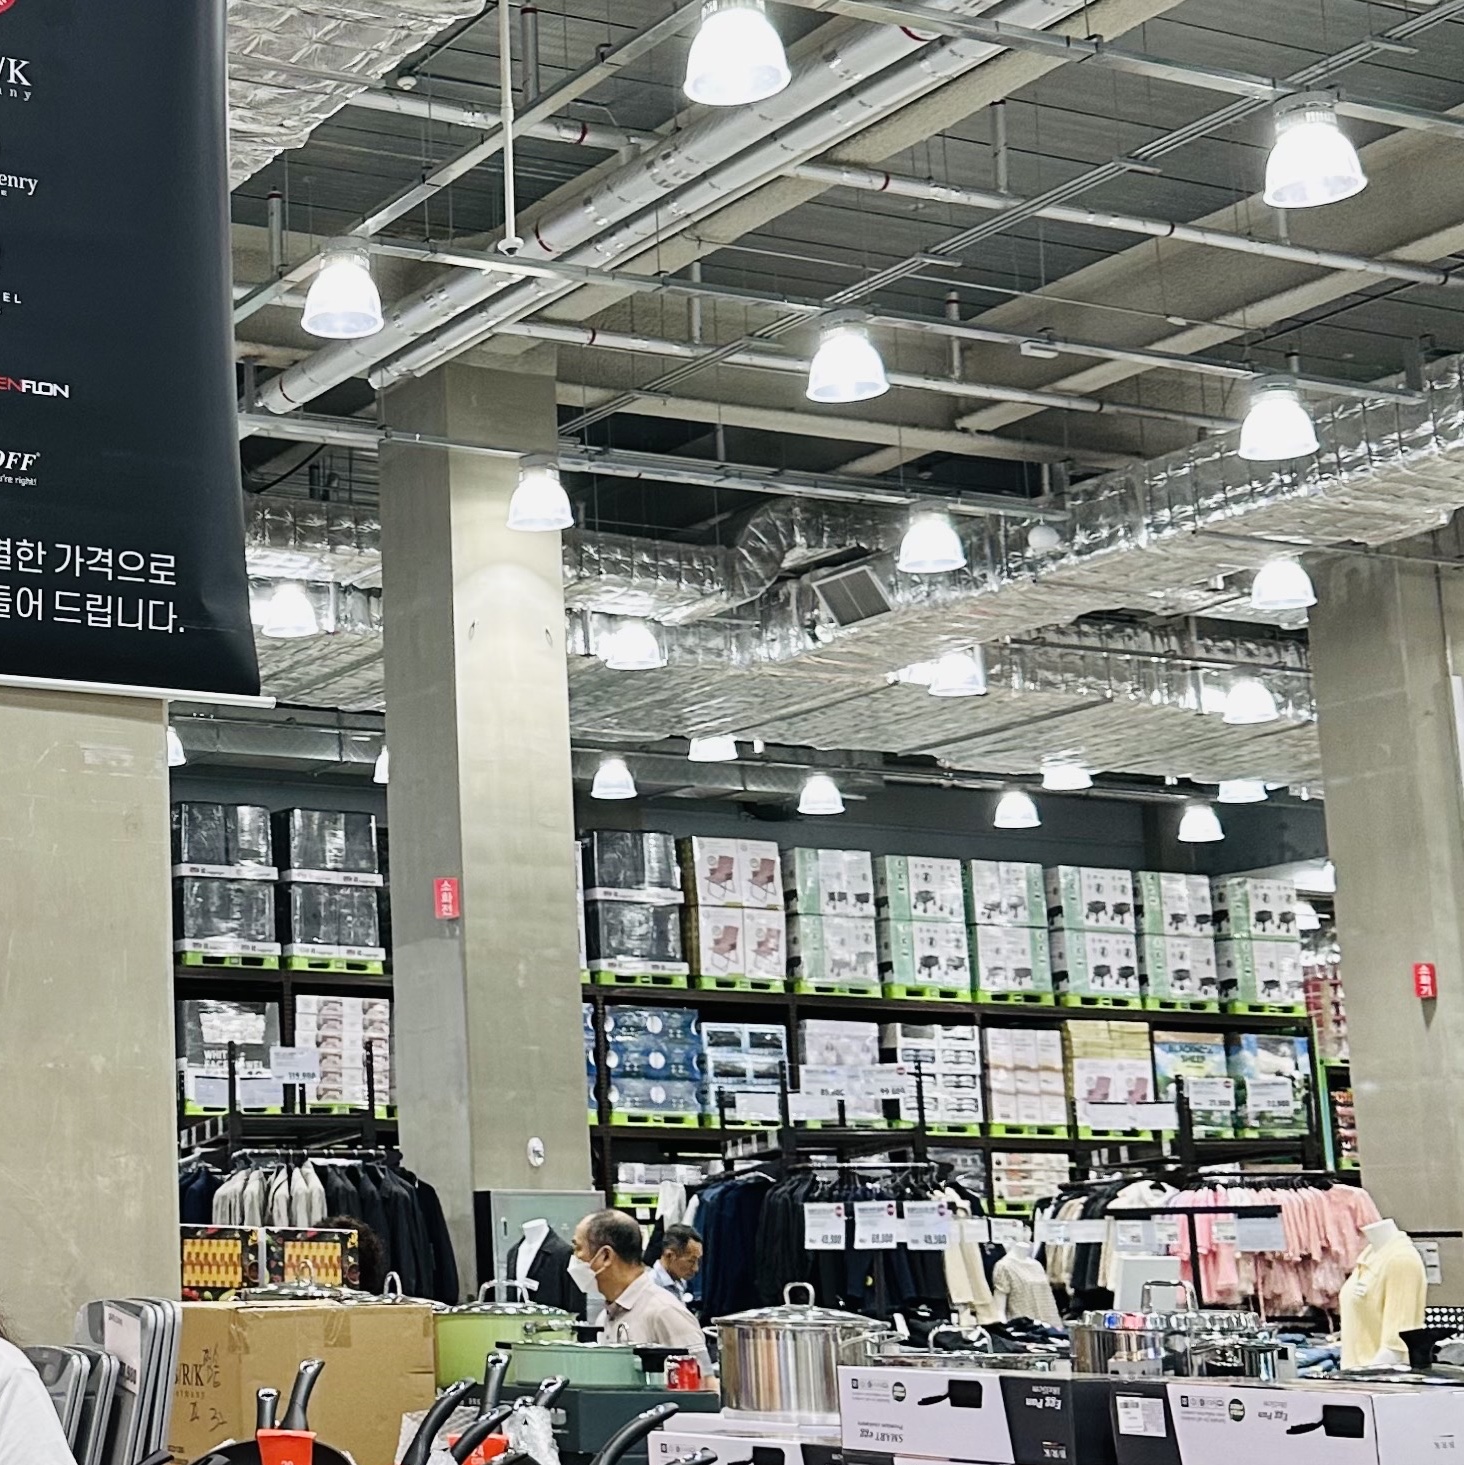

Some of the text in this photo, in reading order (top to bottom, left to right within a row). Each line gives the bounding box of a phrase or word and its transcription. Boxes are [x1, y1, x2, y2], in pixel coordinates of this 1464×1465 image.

[54, 543, 177, 587] 가격으로
[53, 594, 185, 635] 드립니다.
[204, 1050, 229, 1059] WHIT
[875, 1431, 903, 1443] SMART
